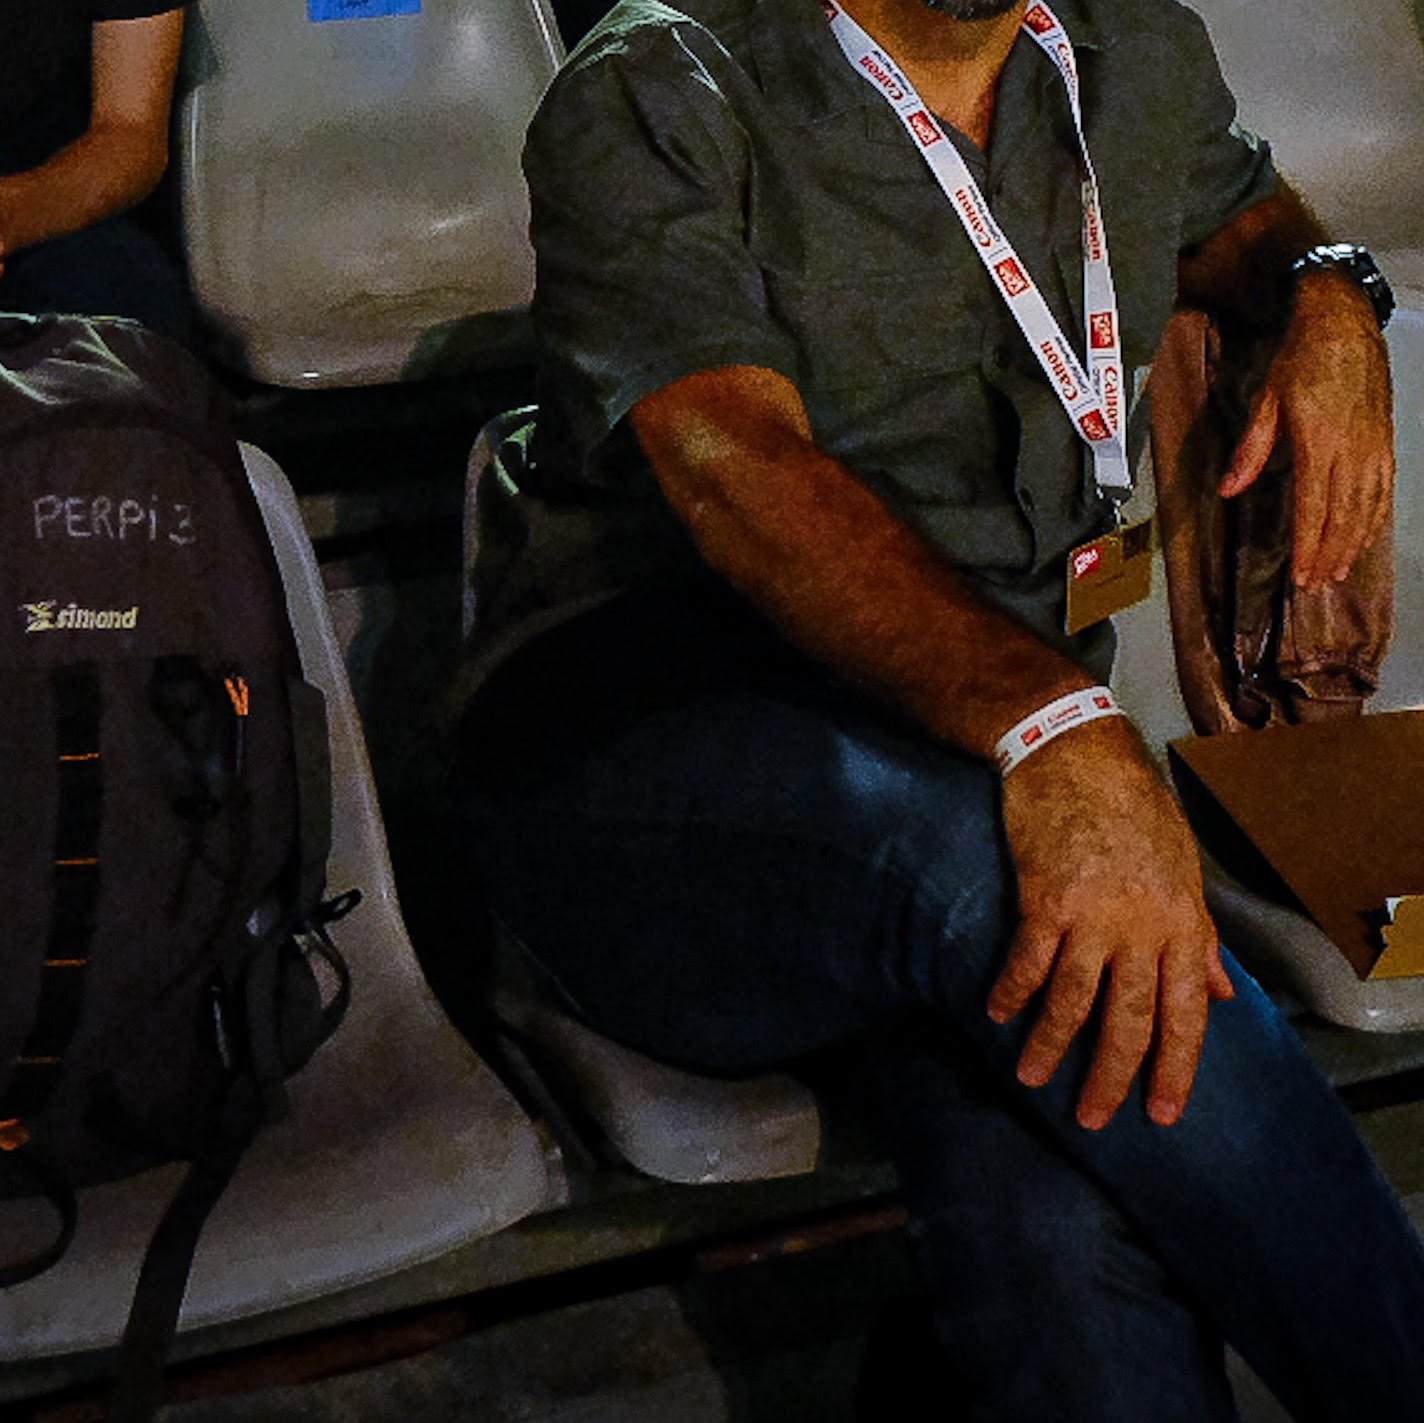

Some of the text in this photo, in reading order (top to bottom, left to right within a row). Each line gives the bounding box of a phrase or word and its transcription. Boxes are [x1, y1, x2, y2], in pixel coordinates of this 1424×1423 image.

[858, 55, 905, 101] Canon
[955, 188, 992, 248] Canon
[1039, 341, 1079, 402] Canon
[54, 602, 140, 630] simond
